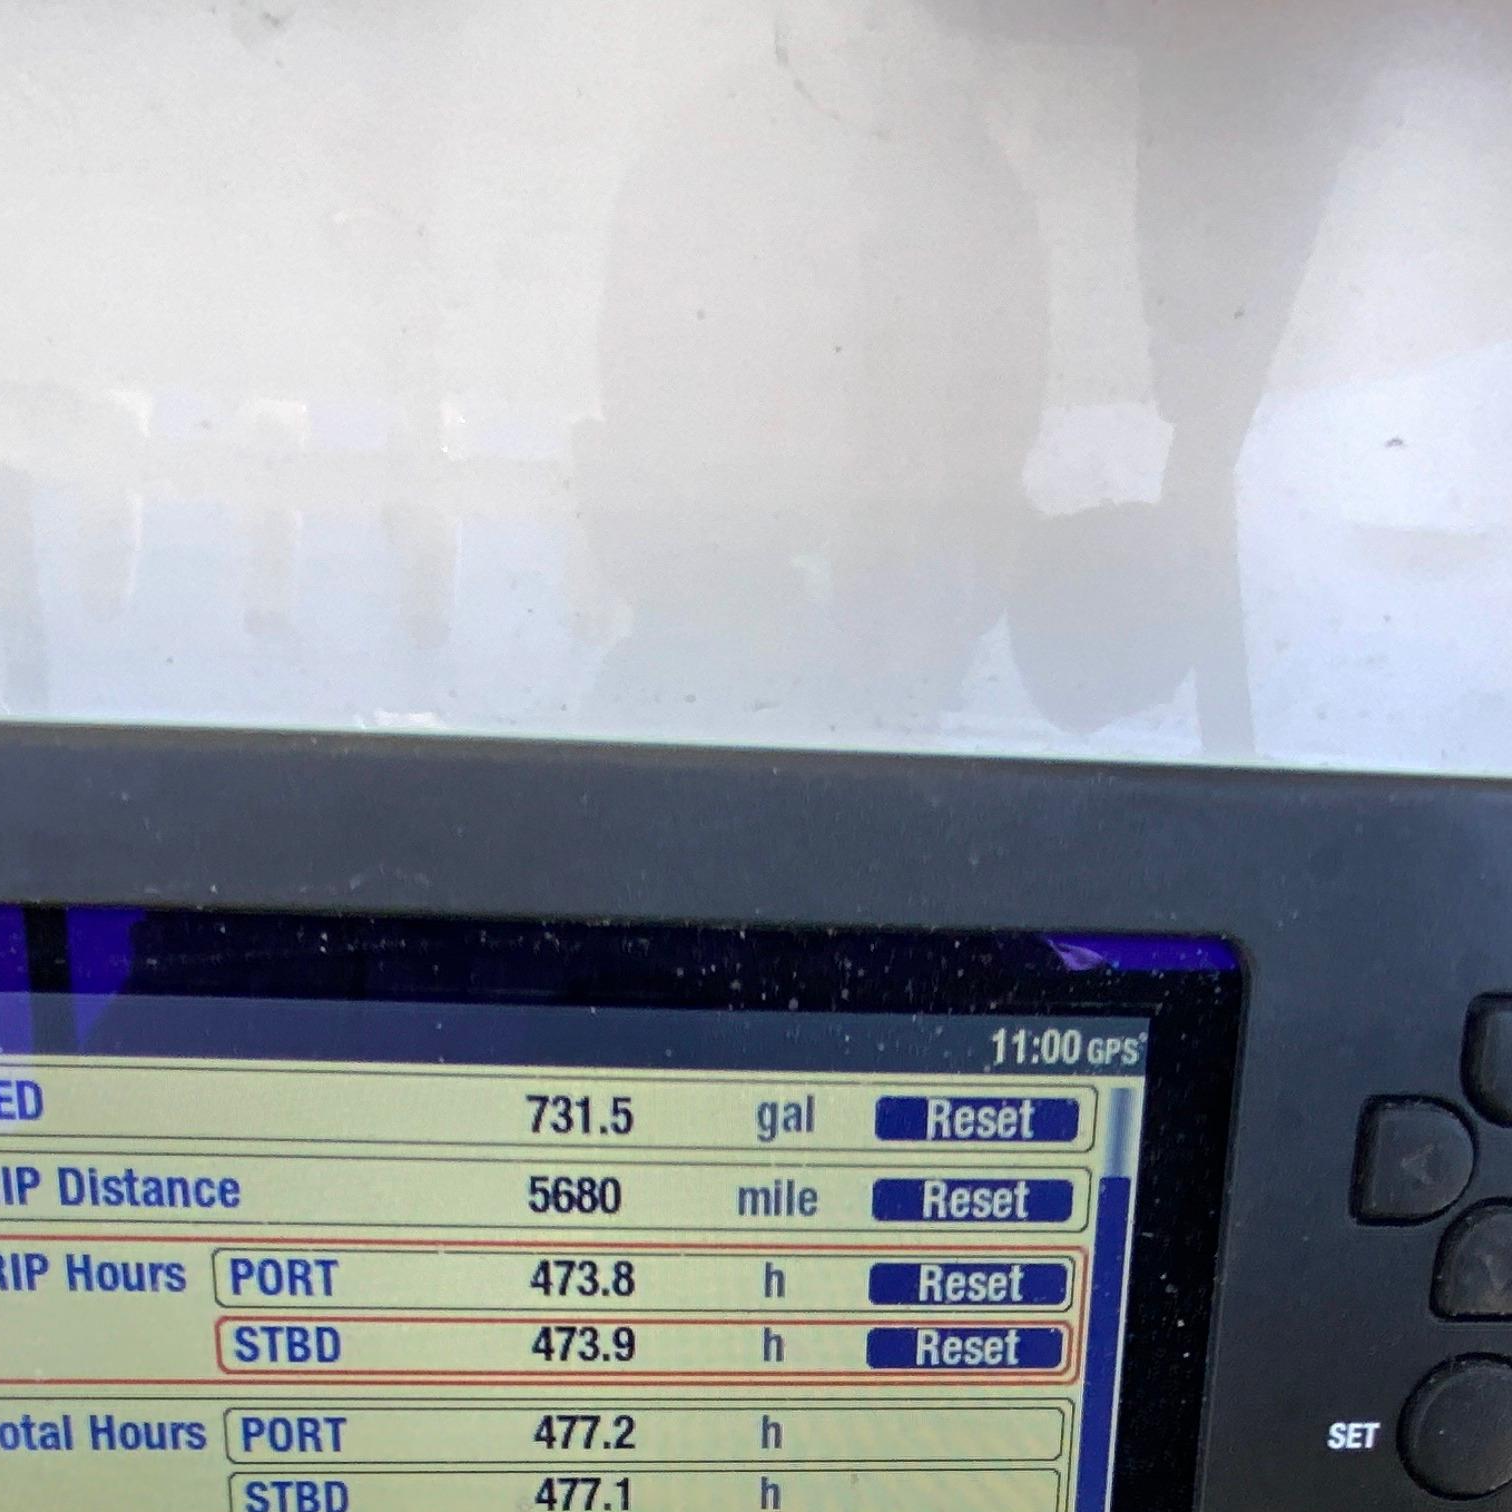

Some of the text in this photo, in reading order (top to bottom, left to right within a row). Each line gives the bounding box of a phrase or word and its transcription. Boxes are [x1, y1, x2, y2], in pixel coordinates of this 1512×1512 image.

[991, 1026, 1141, 1066] 11:00 GPS
[525, 1094, 635, 1136] 731.5
[755, 1095, 816, 1143] gal
[926, 1098, 1035, 1141] Reset
[57, 1167, 242, 1209] Distance
[527, 1175, 622, 1215] 5680
[737, 1177, 819, 1217] mile
[922, 1179, 1030, 1220] Reset
[65, 1254, 187, 1293] Hours
[229, 1257, 339, 1296] PORT
[529, 1259, 636, 1298] 473.8
[763, 1261, 786, 1298] h
[918, 1263, 1024, 1302] Reset
[233, 1325, 1020, 1366] STBD 473.9 h Reset
[89, 1415, 207, 1451] Hours
[241, 1416, 347, 1453] PORT
[533, 1414, 637, 1450] 477.2
[760, 1414, 783, 1450] h
[1326, 1422, 1380, 1451] SET
[533, 1476, 633, 1512] 477.1
[760, 1476, 783, 1511] h
